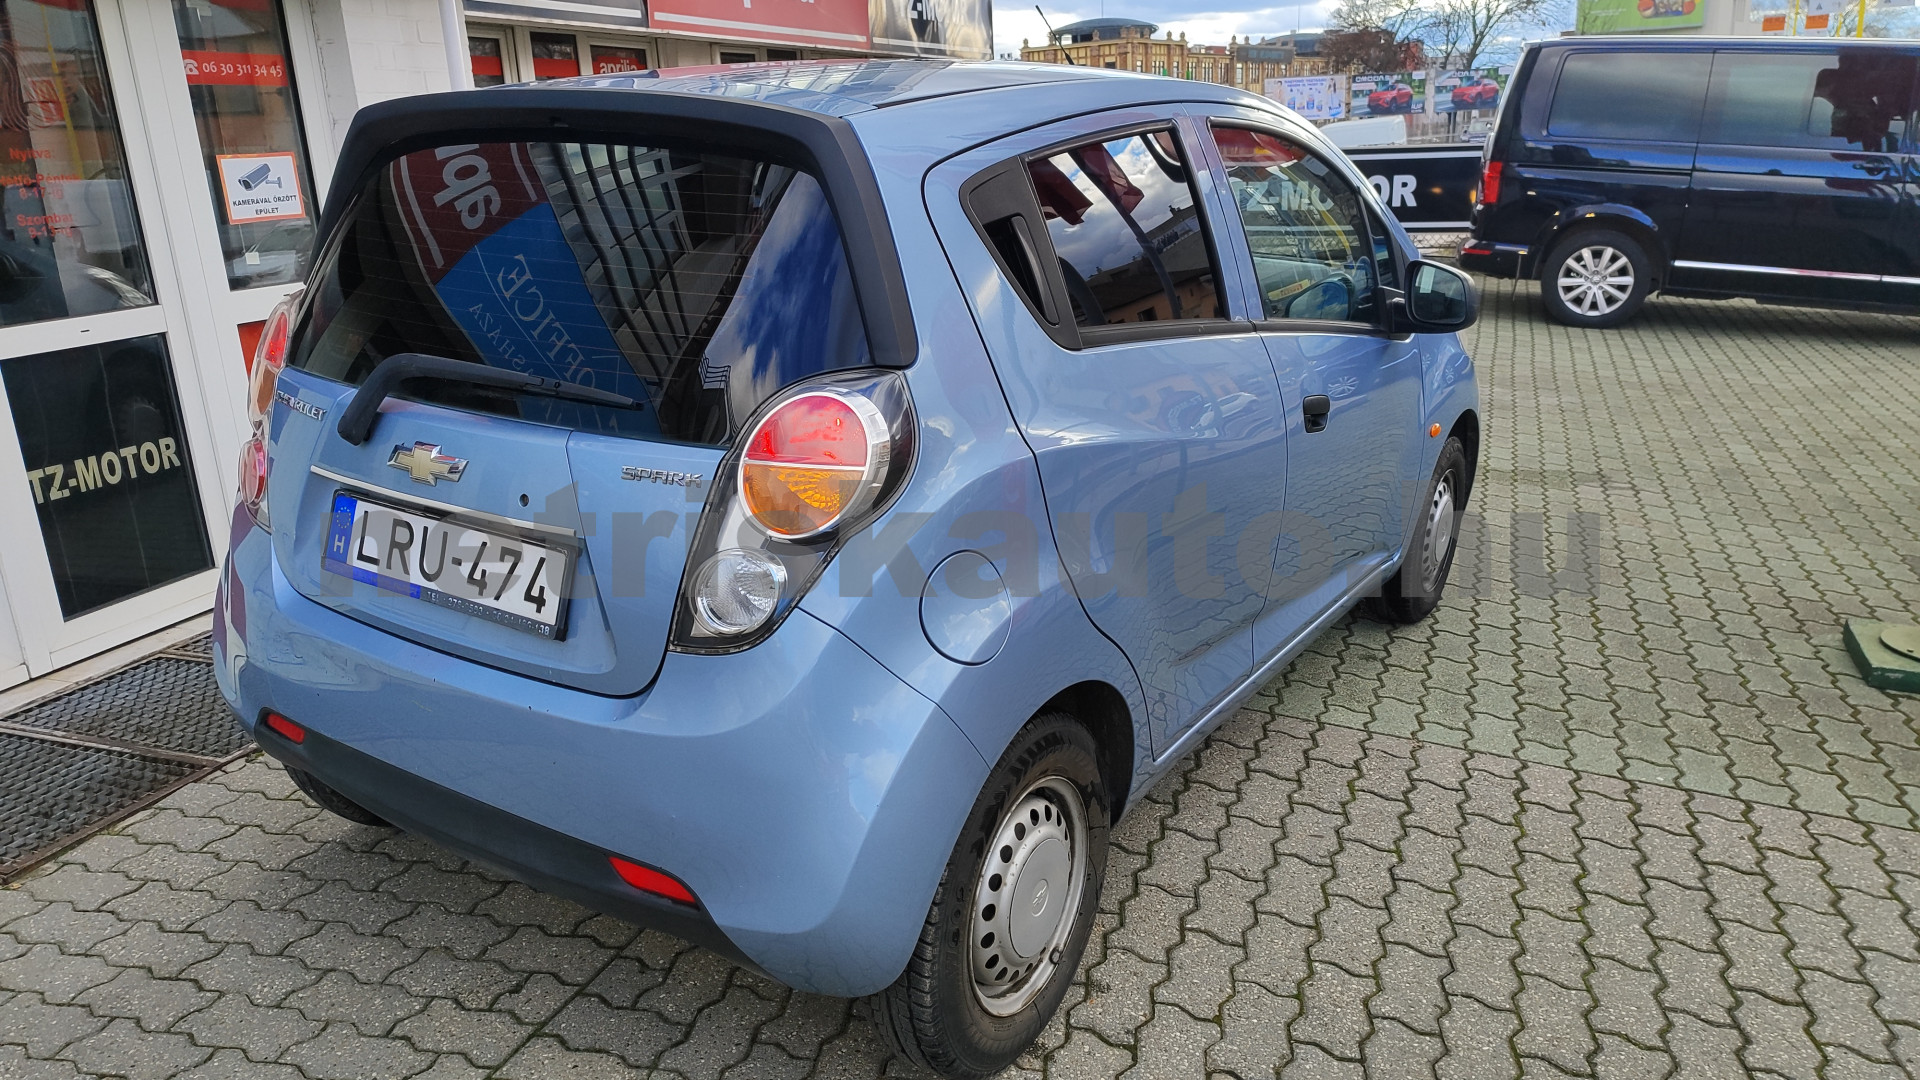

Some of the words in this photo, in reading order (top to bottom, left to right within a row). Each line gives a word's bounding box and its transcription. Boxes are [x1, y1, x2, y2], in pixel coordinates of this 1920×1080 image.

[202, 61, 217, 73] 06
[220, 63, 234, 76] 30
[236, 64, 252, 77] 311
[254, 64, 267, 77] 34
[269, 65, 282, 78] 45
[27, 436, 181, 505] TZ-MOTOR
[621, 465, 704, 489] SPARK
[333, 534, 345, 554] H
[356, 510, 548, 615] LRU-474
